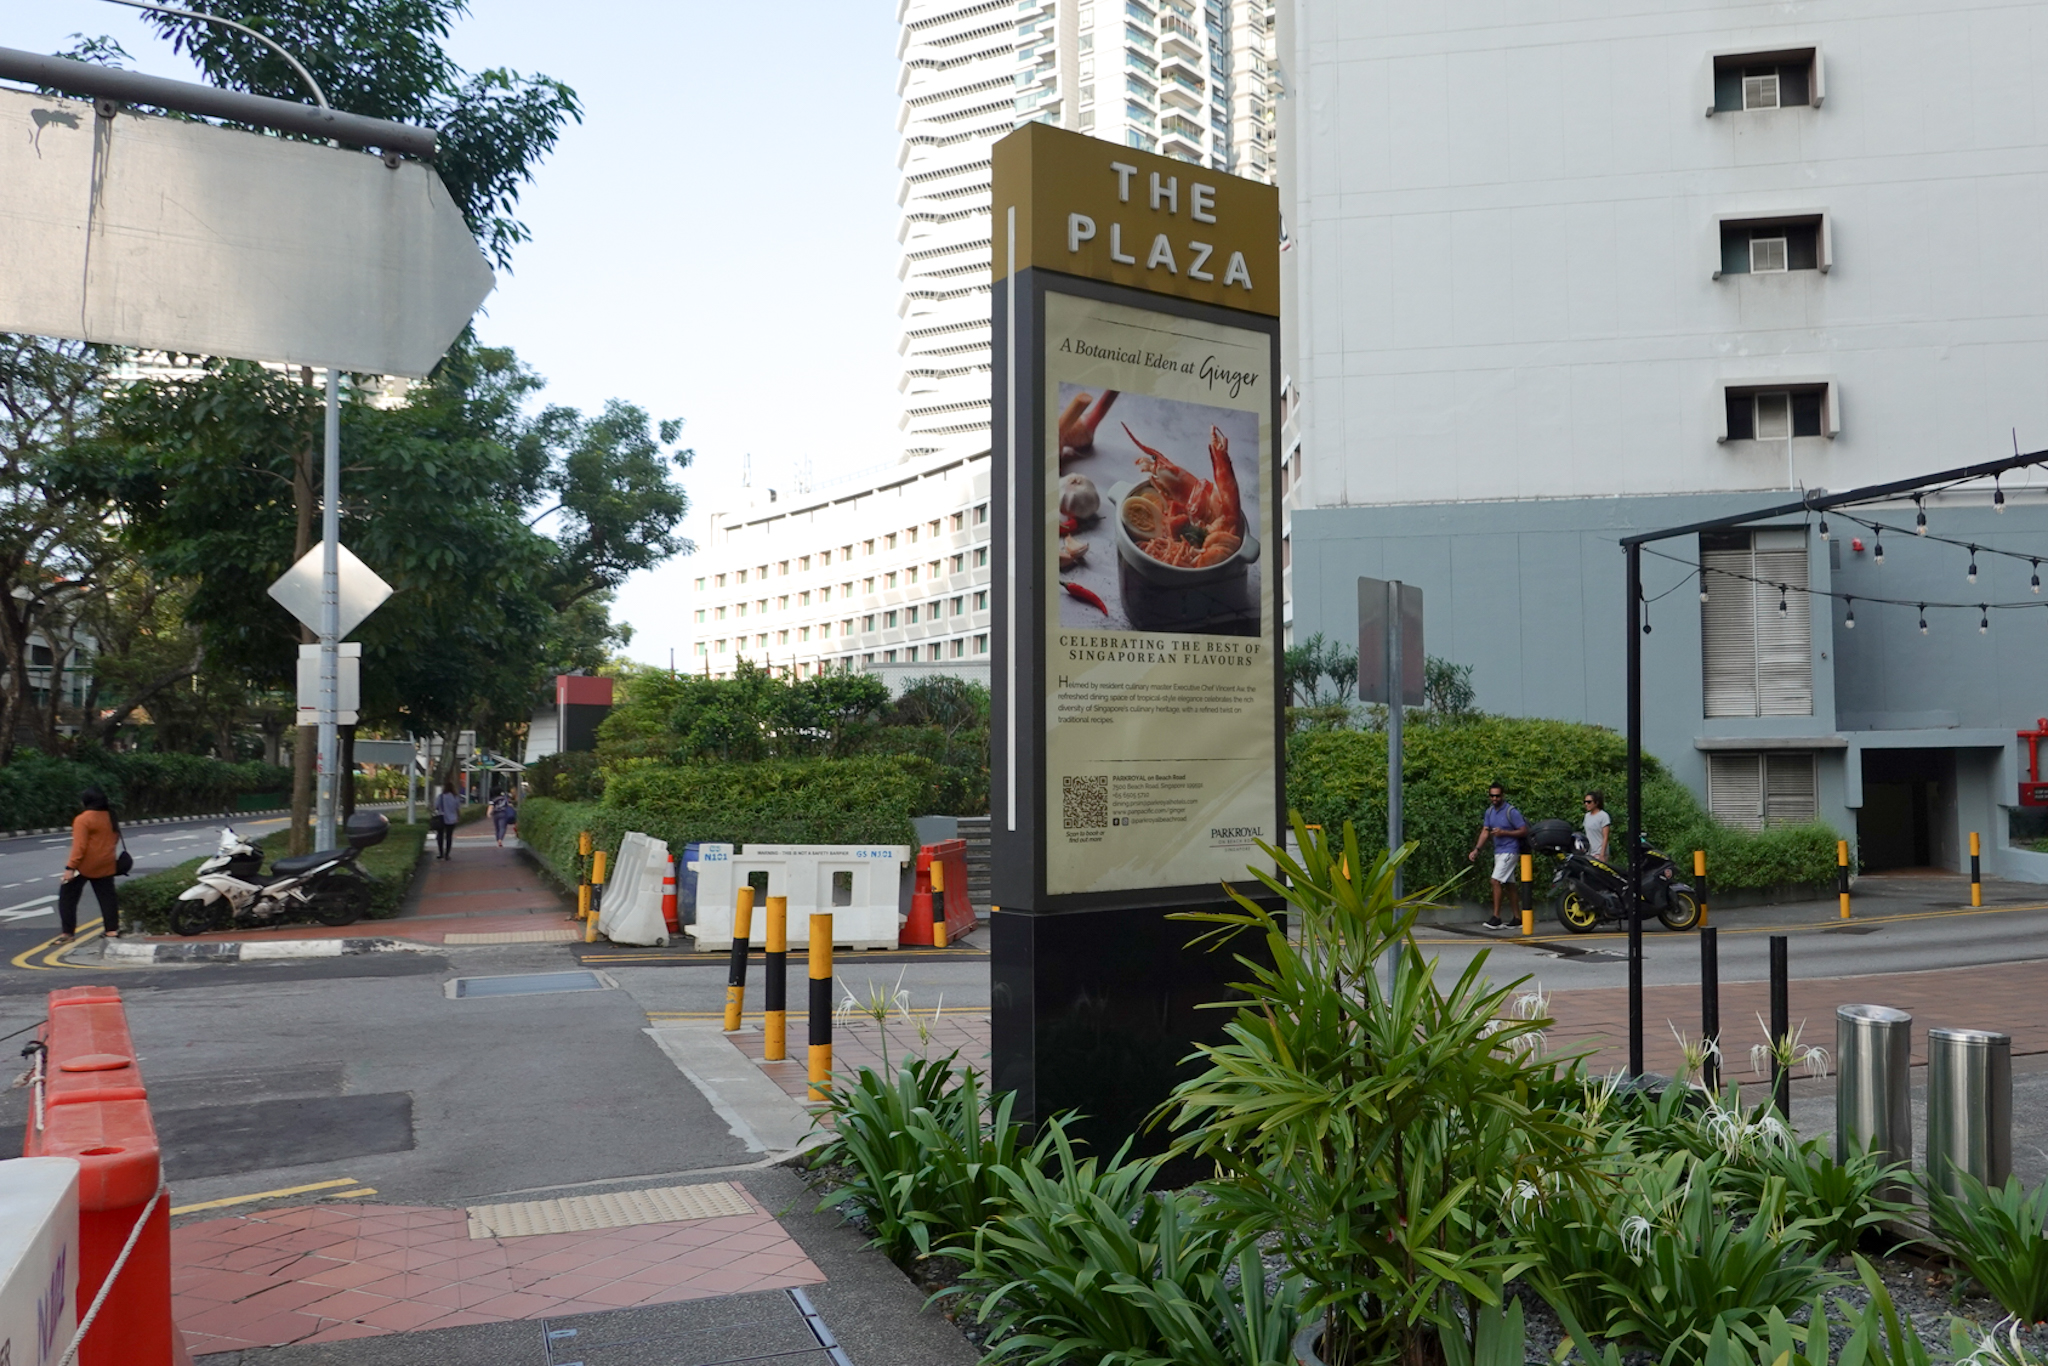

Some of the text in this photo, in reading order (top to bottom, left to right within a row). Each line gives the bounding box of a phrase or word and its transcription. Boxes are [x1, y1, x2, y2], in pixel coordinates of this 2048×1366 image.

[1110, 161, 1216, 224] THE
[1068, 212, 1253, 290] PLAZA
[1059, 338, 1259, 398] A Botanical Eden at Ginger
[1059, 636, 1261, 654] CELEBRATING THE BEST OF
[1069, 650, 1252, 666] SINGAPOREAN FLAVOURS
[1058, 675, 1089, 688] Helmed
[1091, 682, 1098, 691] by
[1100, 682, 1124, 690] resident
[1125, 683, 1149, 692] culinary
[1173, 683, 1200, 691] Executive
[1201, 684, 1214, 692] Chef
[1215, 684, 1236, 692] Vincent
[1058, 692, 1089, 700] refreshed
[1090, 693, 1108, 702] dining
[1110, 694, 1128, 702] space
[1129, 693, 1136, 701] of
[1137, 694, 1176, 703] tropical-style
[1178, 694, 1203, 703] elegance
[1204, 695, 1232, 703] celebrates
[1058, 704, 1084, 713] diversity
[1094, 705, 1128, 714] Singapore's
[1130, 706, 1154, 714] culinary
[1091, 717, 1114, 725] recipes.
[1211, 827, 1264, 838] PARKROYAL
[704, 853, 728, 861] N101
[856, 850, 867, 858] GS
